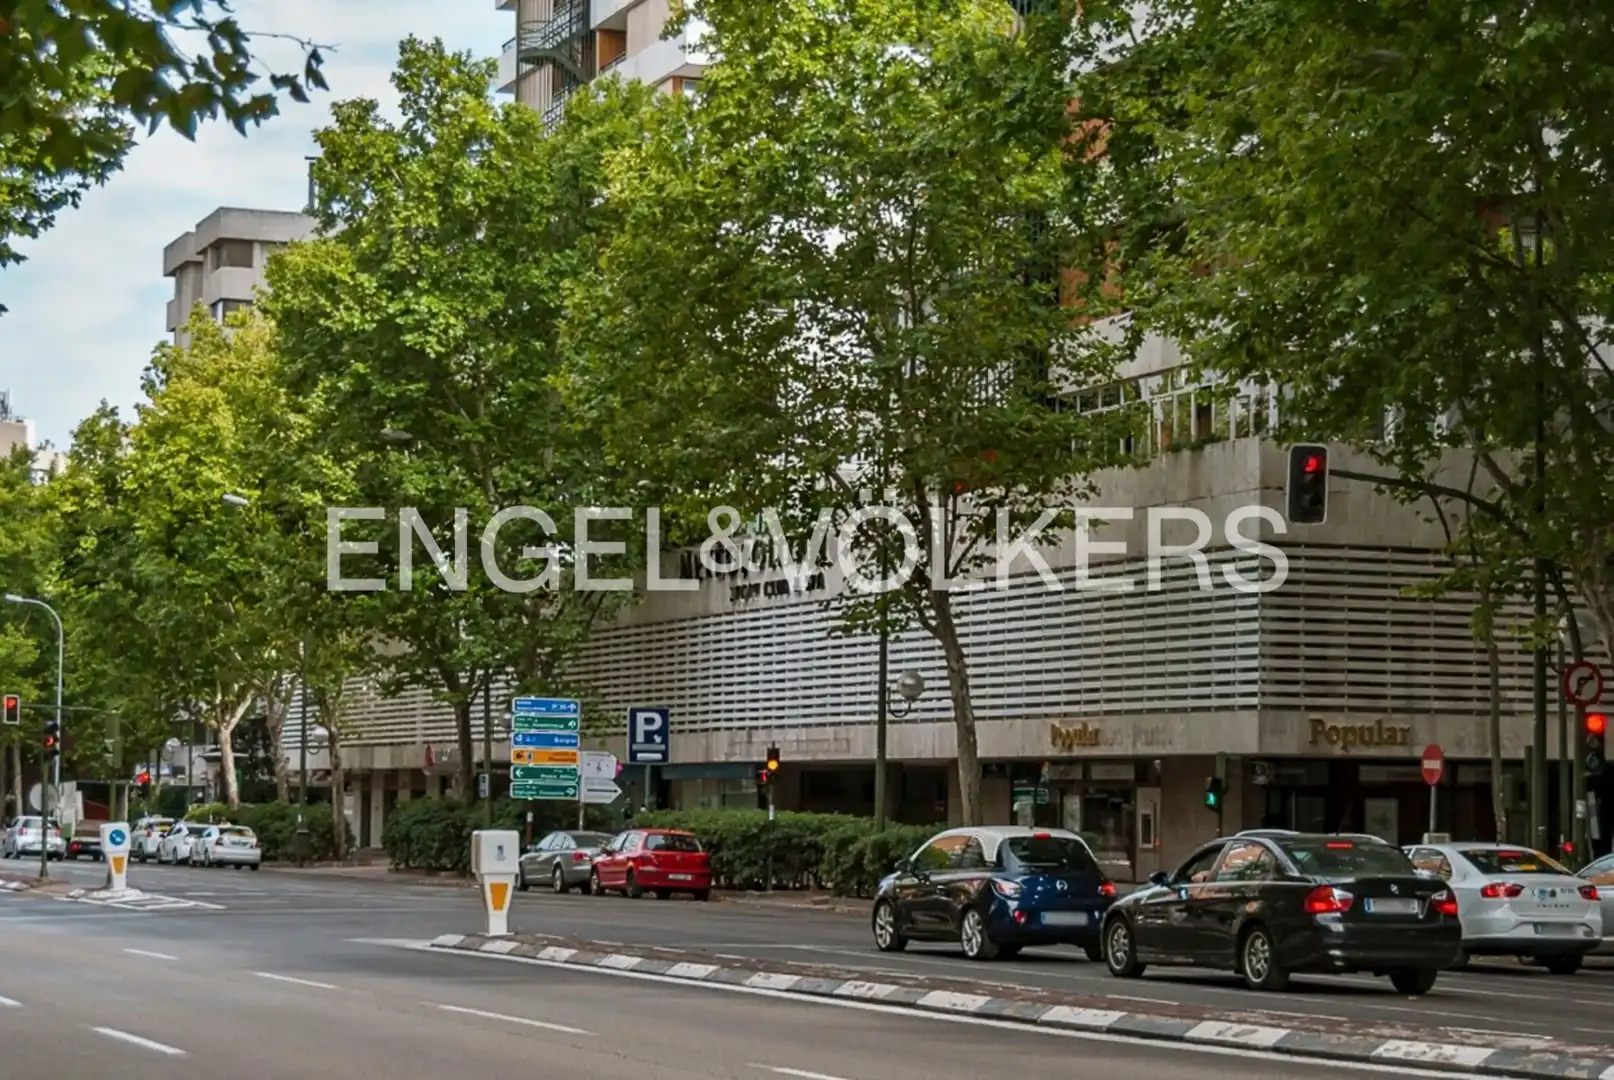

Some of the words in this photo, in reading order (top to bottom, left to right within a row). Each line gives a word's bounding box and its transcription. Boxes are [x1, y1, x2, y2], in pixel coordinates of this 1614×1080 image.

[636, 712, 662, 743] P
[1051, 722, 1100, 751] Popular
[1309, 718, 1412, 751] Popular
